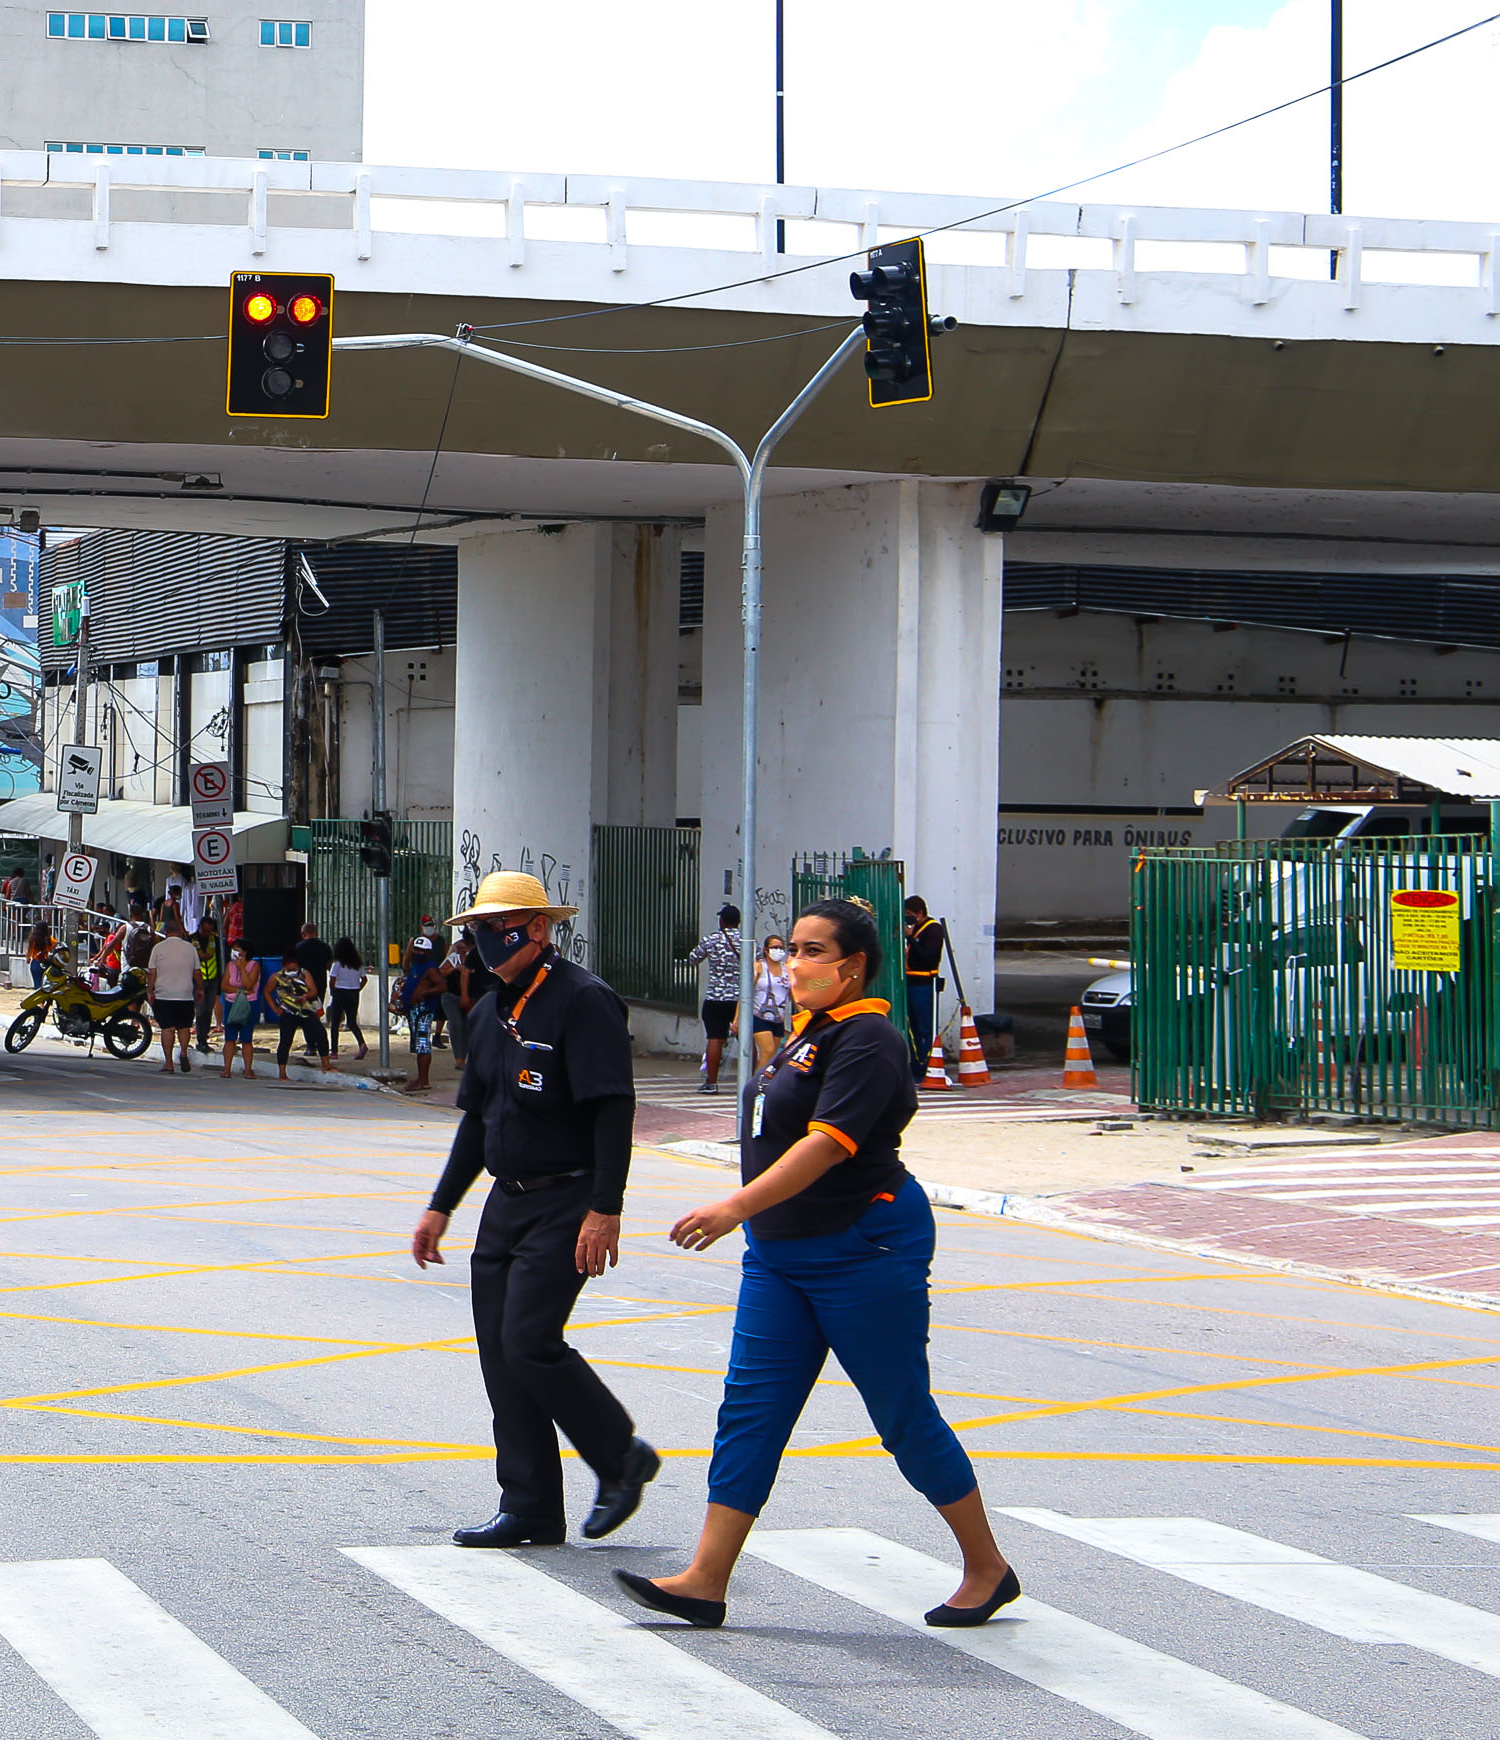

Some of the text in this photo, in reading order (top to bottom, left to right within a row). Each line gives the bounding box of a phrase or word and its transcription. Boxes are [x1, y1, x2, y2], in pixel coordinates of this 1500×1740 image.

[236, 274, 261, 282] 1177 B
[1072, 829, 1114, 846] PARA
[1123, 824, 1193, 847] ÔNIBUS
[206, 839, 220, 857] E
[72, 860, 85, 877] E
